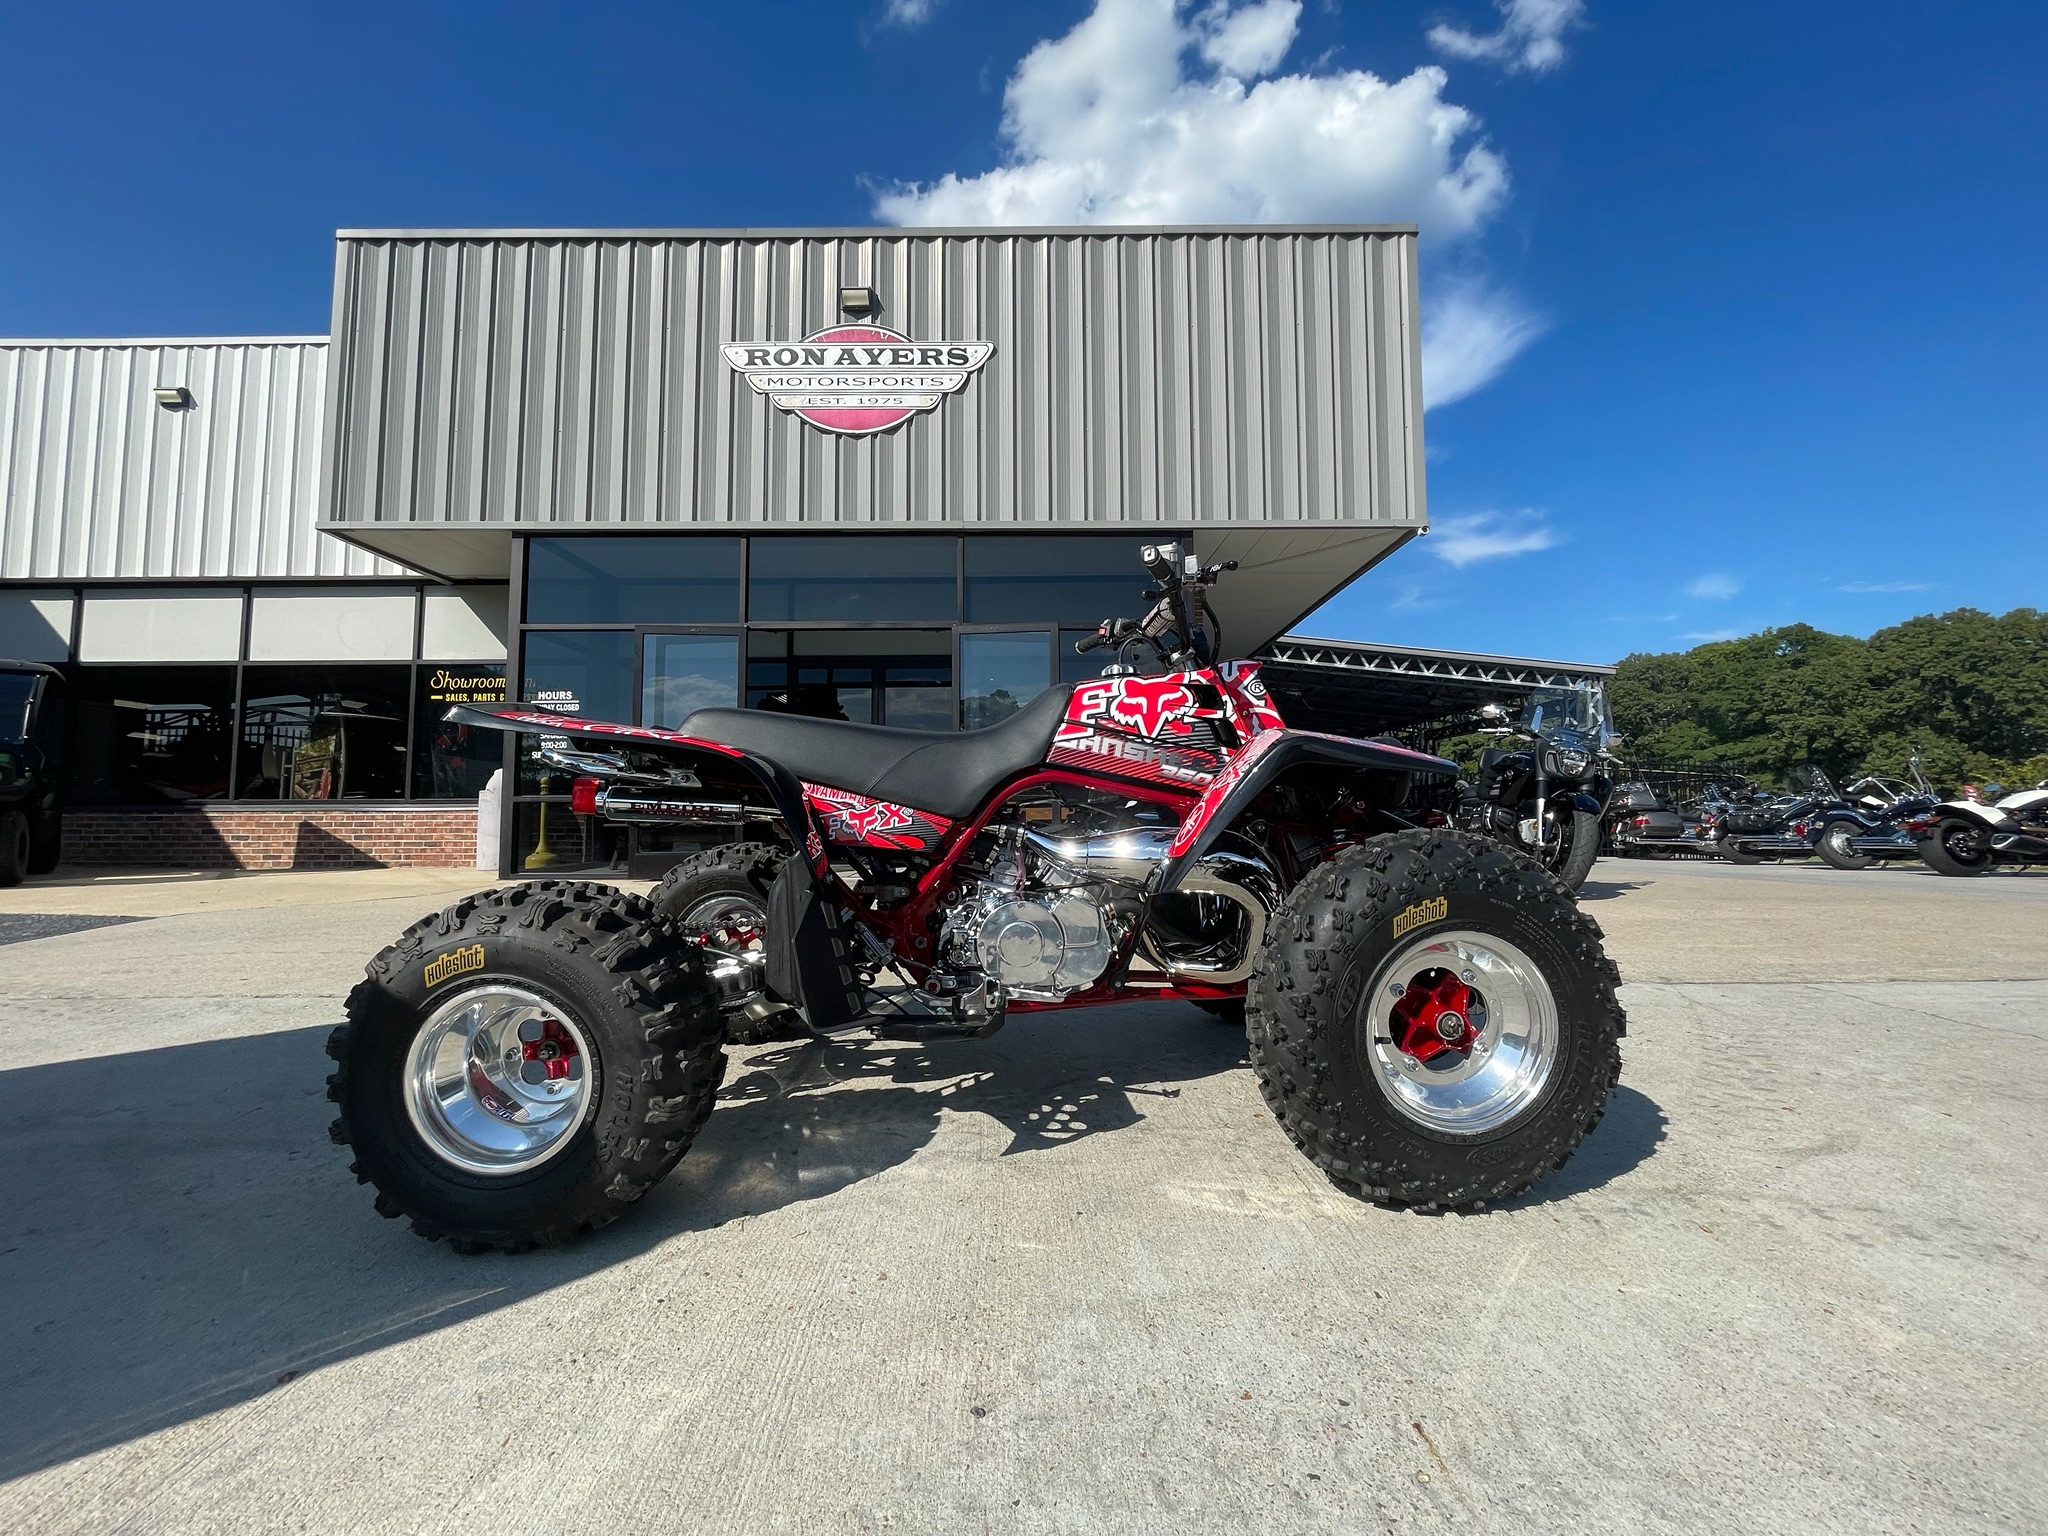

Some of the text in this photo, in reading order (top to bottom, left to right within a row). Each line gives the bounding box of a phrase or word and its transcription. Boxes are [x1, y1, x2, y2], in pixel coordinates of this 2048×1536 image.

[743, 346, 970, 366] RON AYERS
[767, 376, 944, 387] MOTORSPORTS
[807, 397, 903, 405] EST. 1975
[430, 669, 506, 690] Showroom
[445, 693, 470, 702] SALES,
[473, 693, 496, 702] PARTS
[537, 690, 573, 700] HOURS
[555, 703, 580, 711] CLOSED
[540, 741, 567, 749] 9:00-2:00
[1156, 763, 1214, 785] 350
[1395, 897, 1446, 937] Holeshot
[426, 945, 483, 986] Holeshot
